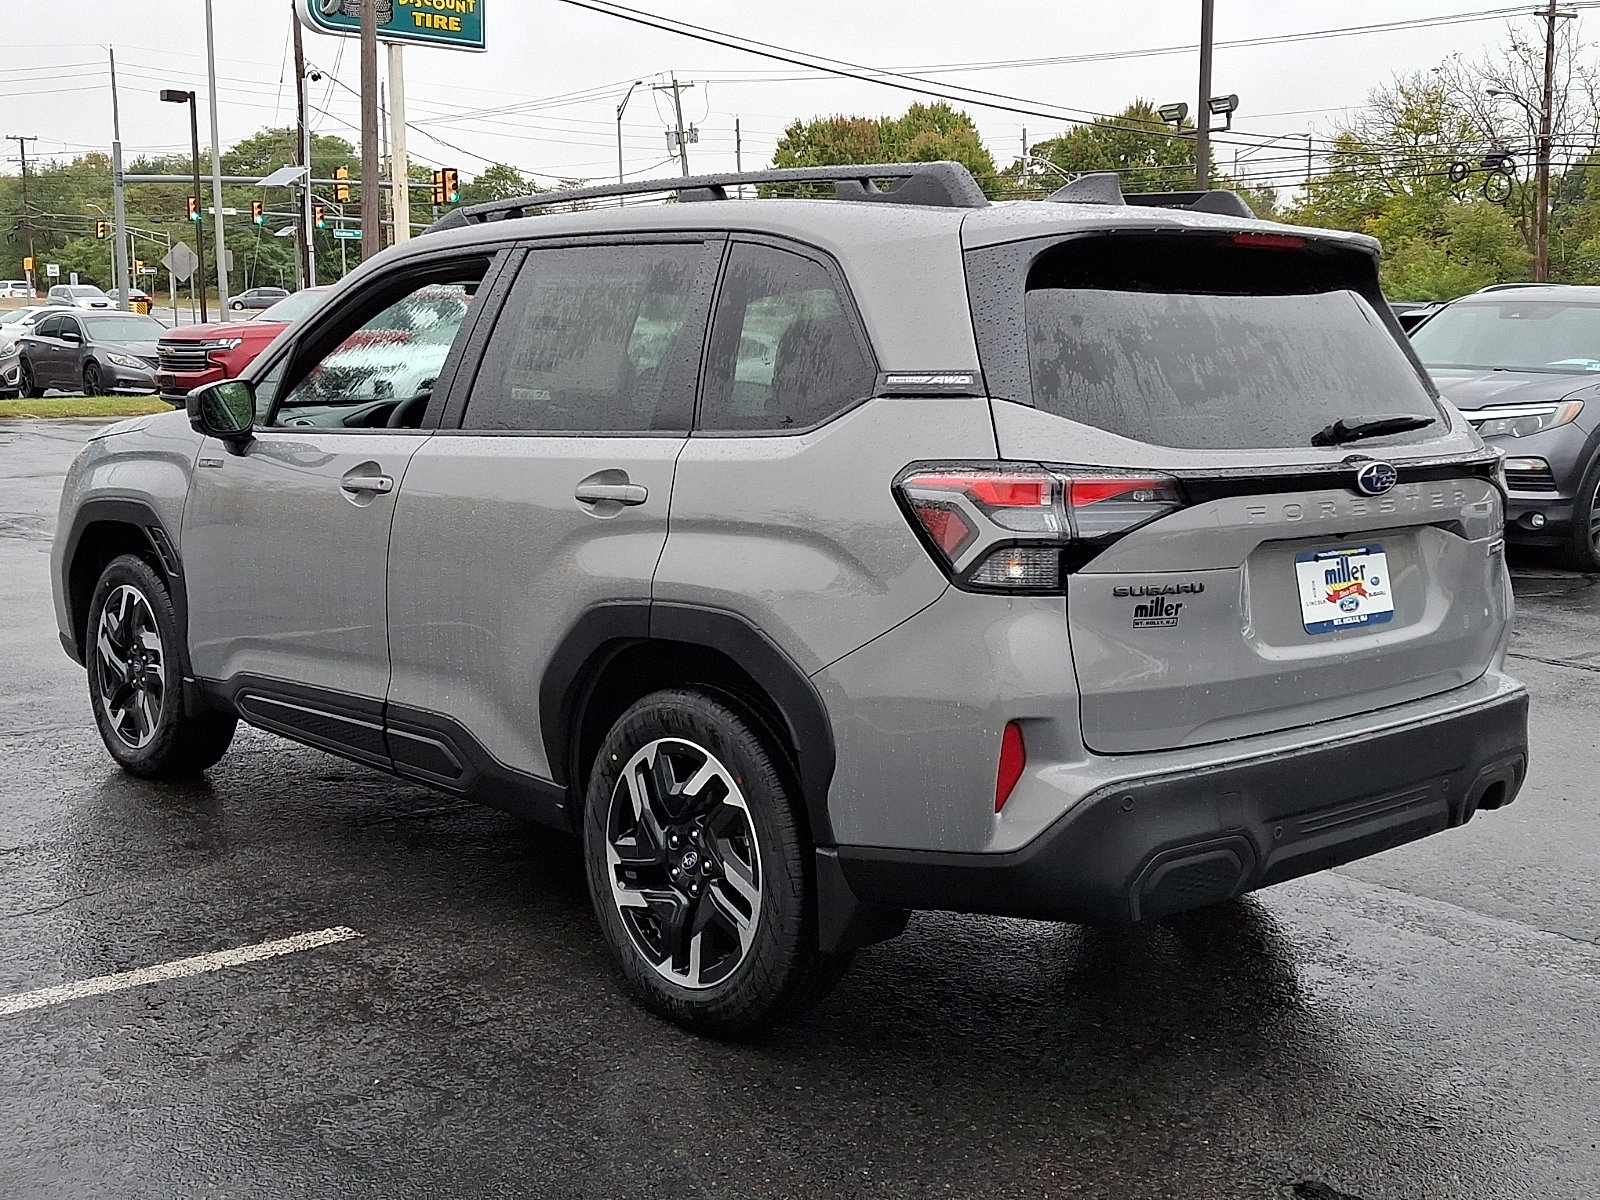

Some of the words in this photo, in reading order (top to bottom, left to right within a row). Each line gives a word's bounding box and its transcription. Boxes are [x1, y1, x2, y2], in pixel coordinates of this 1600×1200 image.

[398, 0, 476, 14] SOUNT
[411, 11, 462, 32] TIRE
[927, 375, 970, 384] AWD
[1246, 490, 1466, 524] FORESTER
[1325, 556, 1365, 585] miller
[1113, 582, 1204, 597] SUBARU
[1134, 596, 1183, 617] miller
